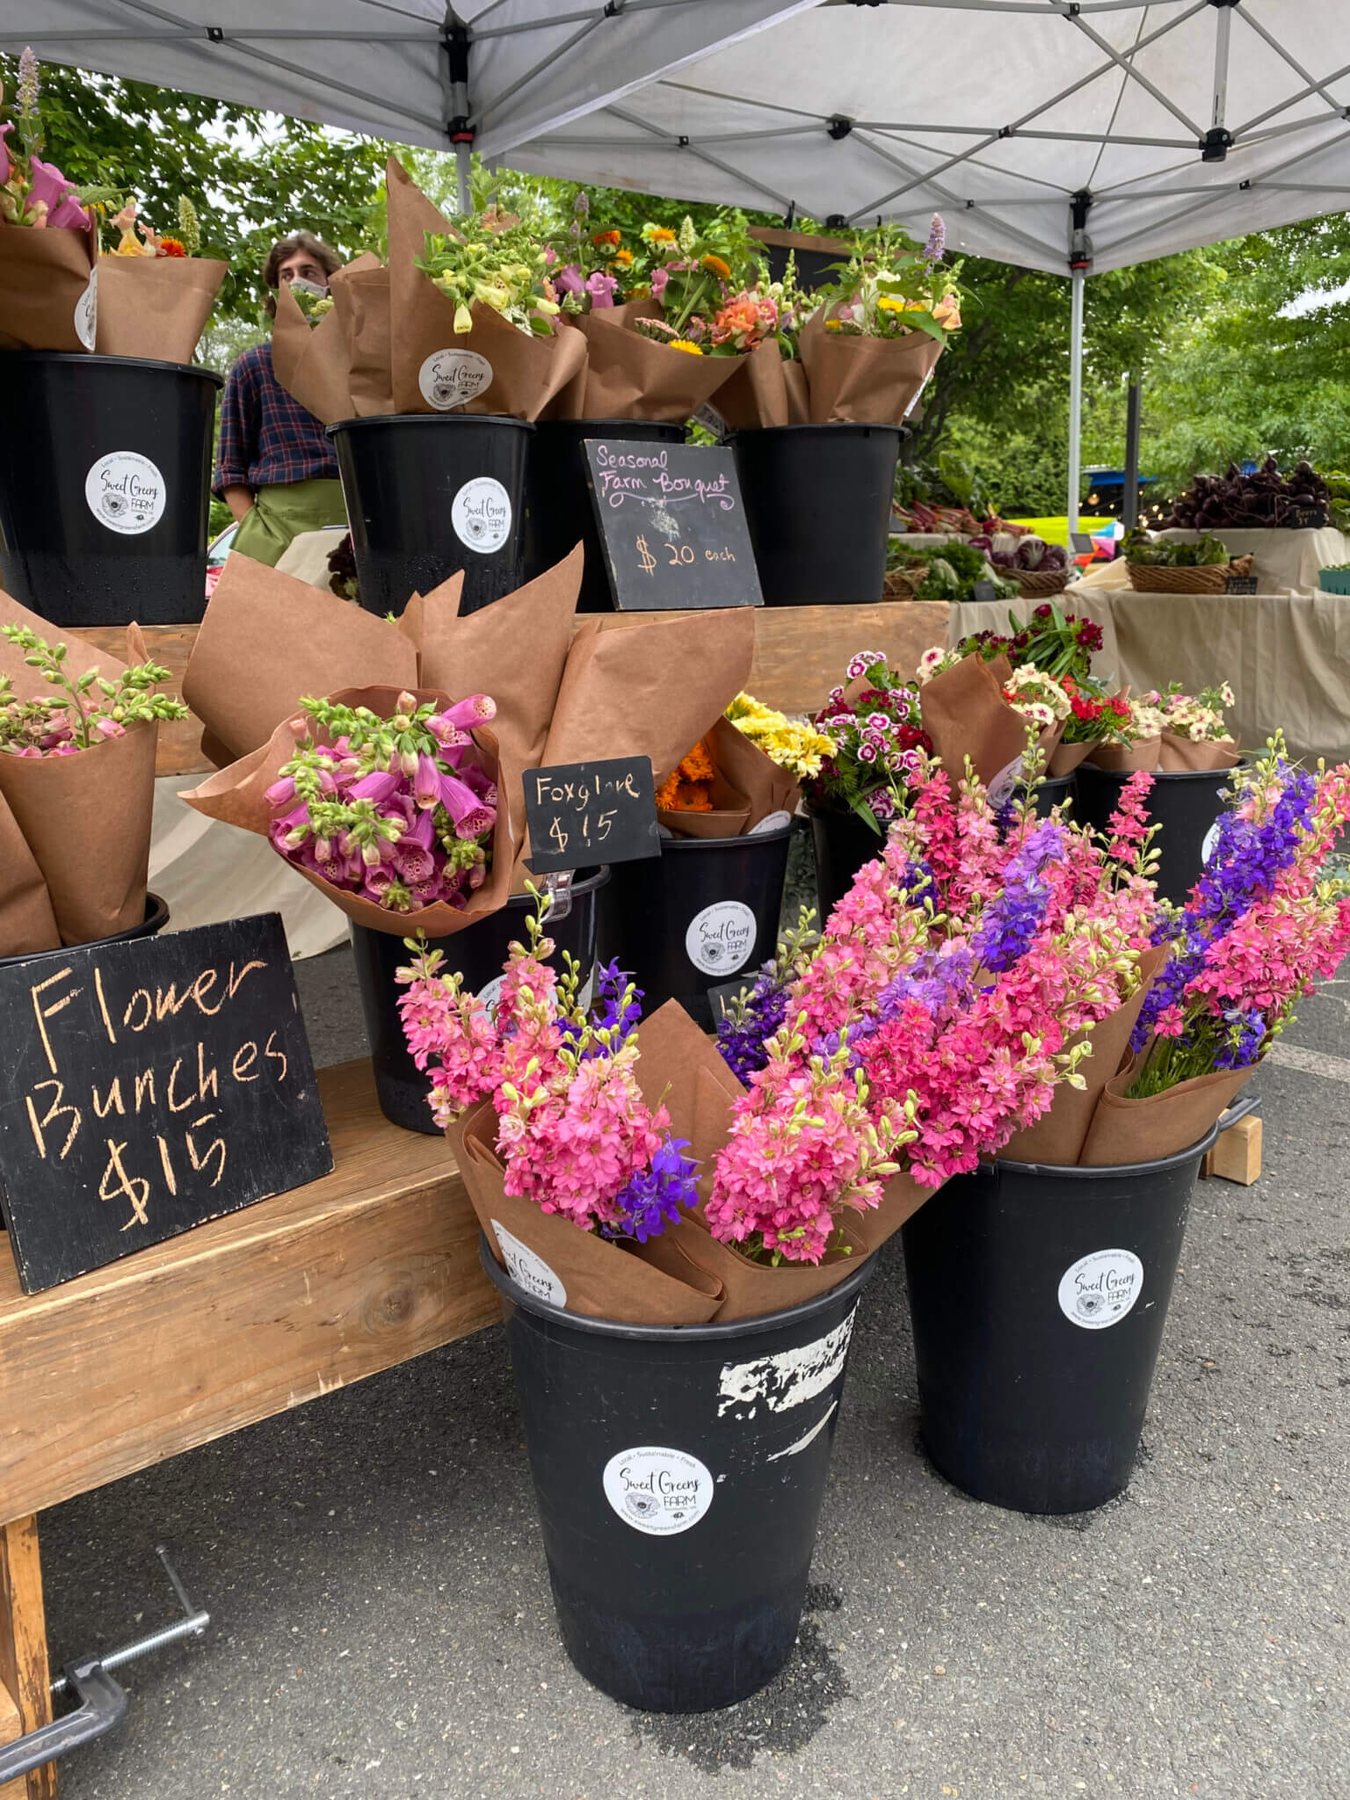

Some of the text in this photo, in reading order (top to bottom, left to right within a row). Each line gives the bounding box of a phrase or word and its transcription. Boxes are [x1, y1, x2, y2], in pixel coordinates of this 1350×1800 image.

[431, 363, 457, 383] Sweet
[597, 445, 668, 471] Seasonal
[100, 469, 129, 495] Sweet
[599, 470, 731, 503] Farm Bouquet
[130, 498, 155, 510] FARM
[463, 496, 485, 518] Sweet
[705, 546, 736, 563] each
[699, 921, 725, 943] Sweet
[31, 959, 268, 1075] Flower
[25, 1030, 287, 1160] Bunches
[98, 1112, 226, 1232] $15
[1074, 1272, 1105, 1295] Sweet
[1107, 1287, 1132, 1302] FARM
[619, 1467, 702, 1495] Sweet Greens
[663, 1495, 697, 1507] FARM
